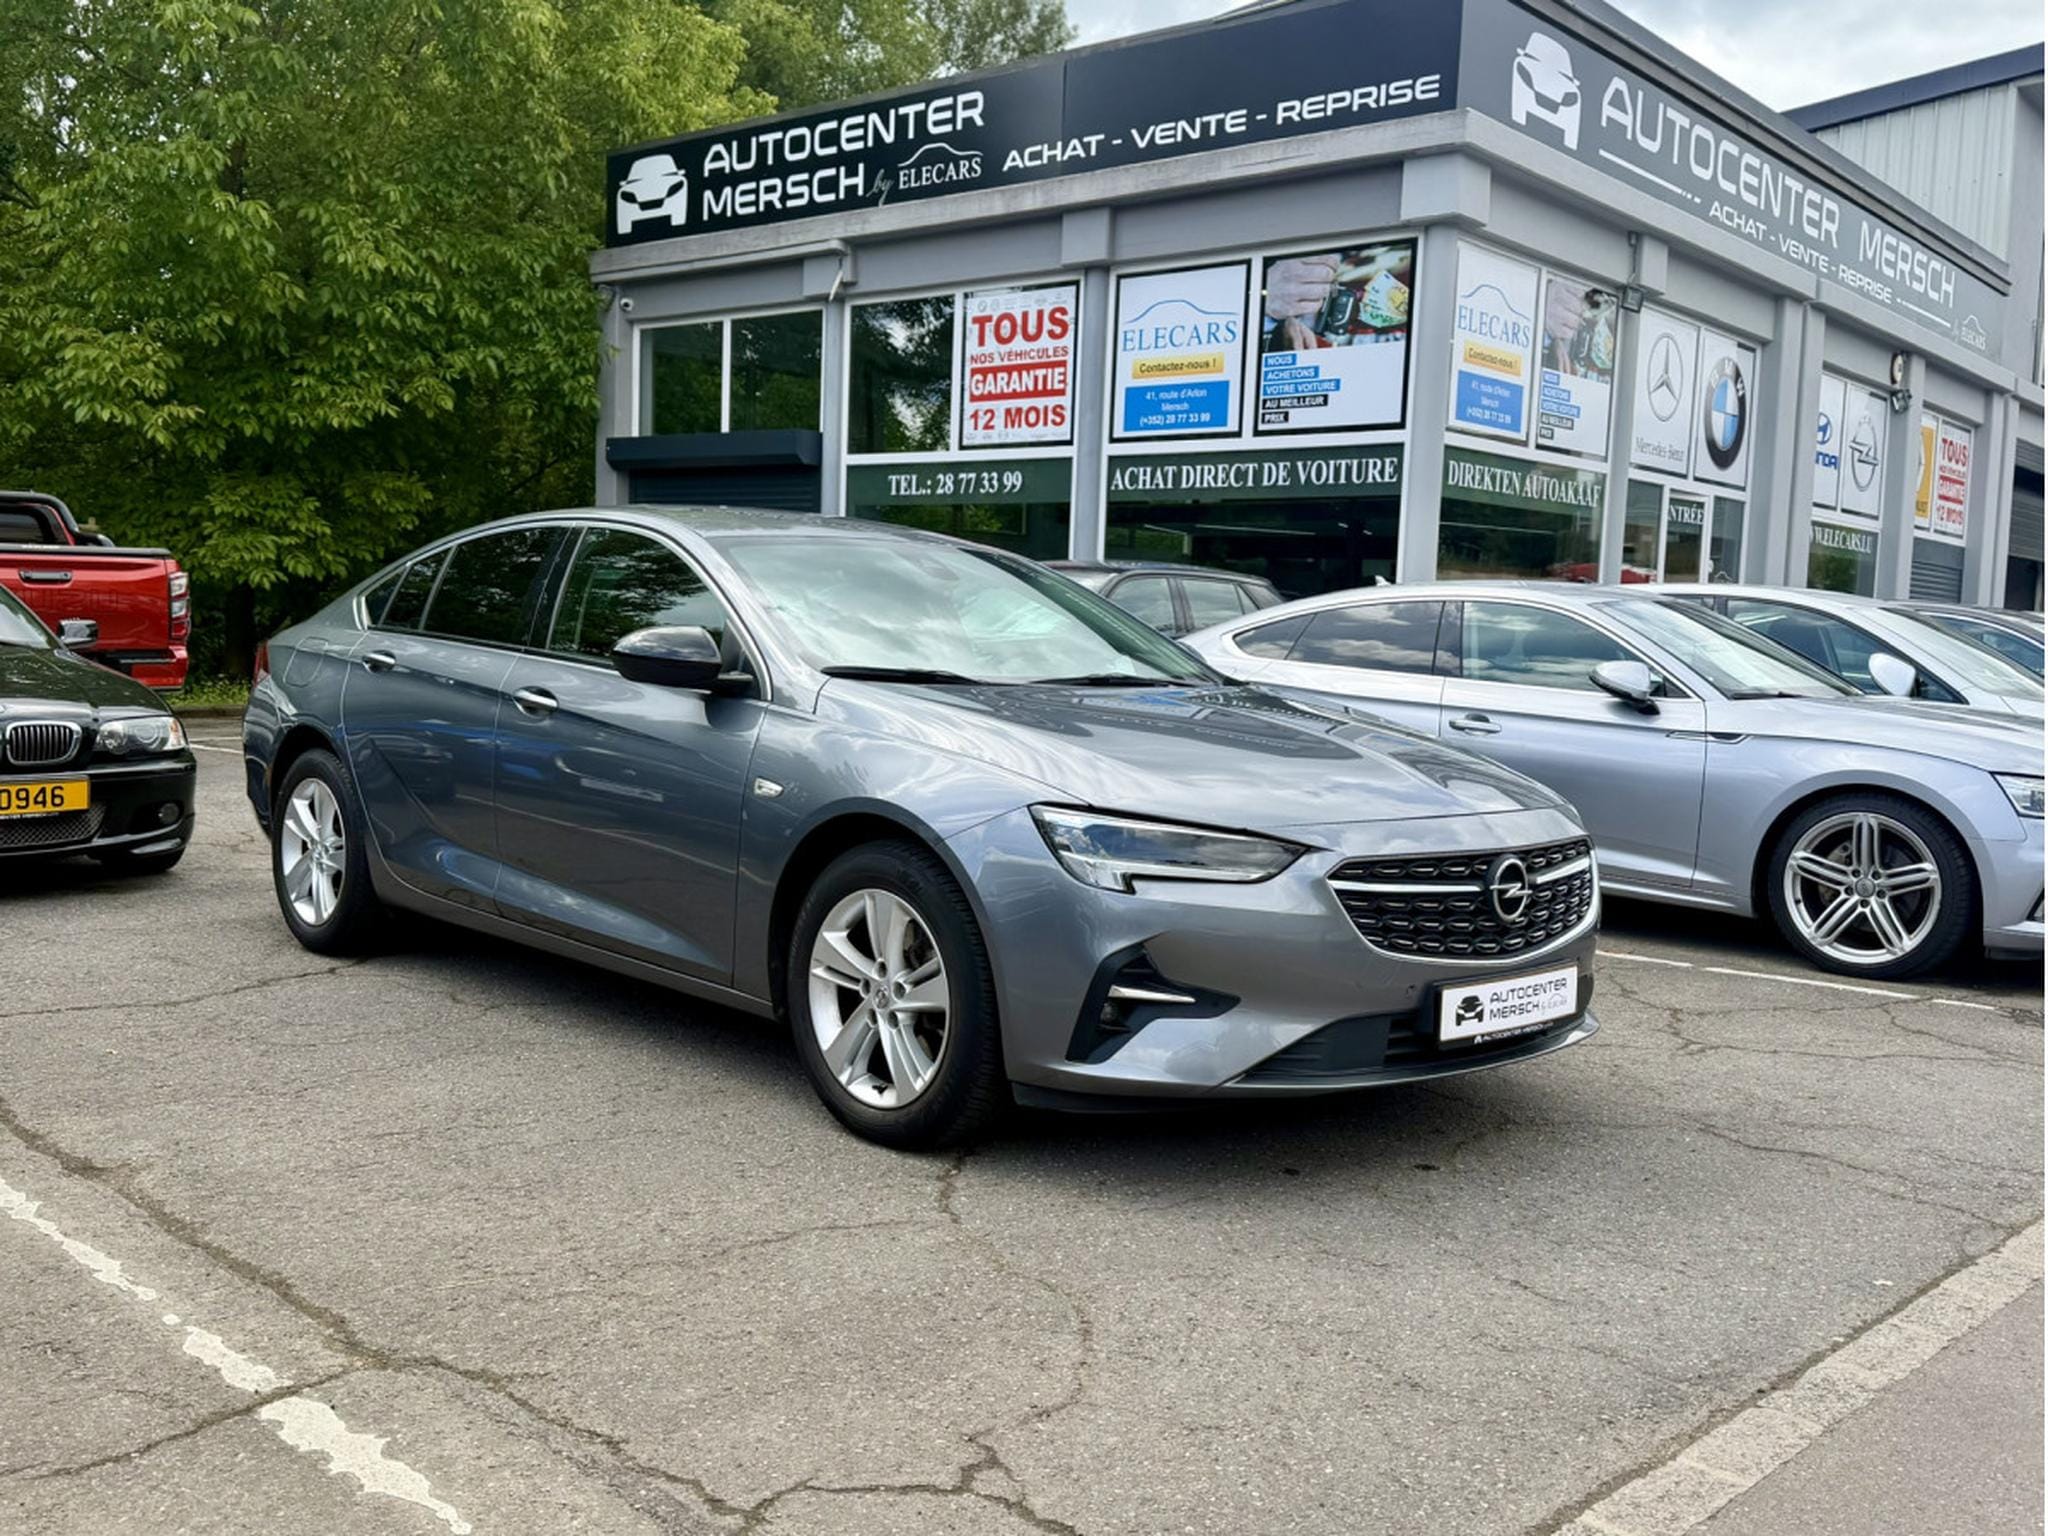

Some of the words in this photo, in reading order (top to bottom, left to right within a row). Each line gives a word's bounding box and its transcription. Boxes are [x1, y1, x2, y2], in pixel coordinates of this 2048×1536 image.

[702, 91, 984, 178] AUTOCENTER
[1002, 134, 1105, 171] ACHAT
[1131, 109, 1248, 149] VENTE
[1276, 74, 1441, 125] REPRISE
[702, 163, 864, 221] MERSCH
[866, 168, 894, 208] by
[899, 156, 982, 190] ELECARS
[1601, 76, 1840, 248] AUTOCENTER
[1859, 220, 1956, 308] MERSCH
[1708, 200, 1767, 241] ACHAT
[1779, 233, 1829, 273] VENTE
[1839, 264, 1892, 304] REPRISE
[972, 306, 1070, 347] TOUS
[1122, 320, 1237, 352] ELECARS
[1458, 305, 1531, 349] ELECARS
[970, 352, 995, 365] NOS
[1000, 345, 1069, 362] VÉHICULES
[1139, 358, 1210, 374] Contactez-nous
[1267, 355, 1293, 366] NOUS
[971, 366, 1066, 396] GARANTIE
[1265, 383, 1296, 395] VOTRE
[1297, 380, 1337, 392] VOITURE
[1266, 368, 1316, 380] ACHETONS
[1264, 398, 1279, 408] AU
[1279, 396, 1325, 408] MEILLEUR
[970, 408, 995, 431] 12
[1004, 404, 1066, 429] MOIS
[1177, 412, 1187, 423] 77
[1941, 437, 1969, 467] TOUS
[888, 474, 931, 496] TEL.:
[935, 473, 954, 495] 28
[958, 472, 977, 494] 77
[979, 471, 999, 493] 33
[1002, 471, 1023, 493] 99
[1111, 465, 1177, 491] ACHAT
[1180, 462, 1258, 489] DIRECT
[1262, 461, 1292, 487] DE
[1296, 457, 1399, 486] VOITURE
[1448, 461, 1522, 497] DIREKTEN
[1522, 473, 1602, 508] AUTOAKAAF
[1668, 503, 1705, 525] NTRÉE
[1489, 977, 1568, 1004] AUTOCENTER
[1489, 1002, 1540, 1021] MERSCH
